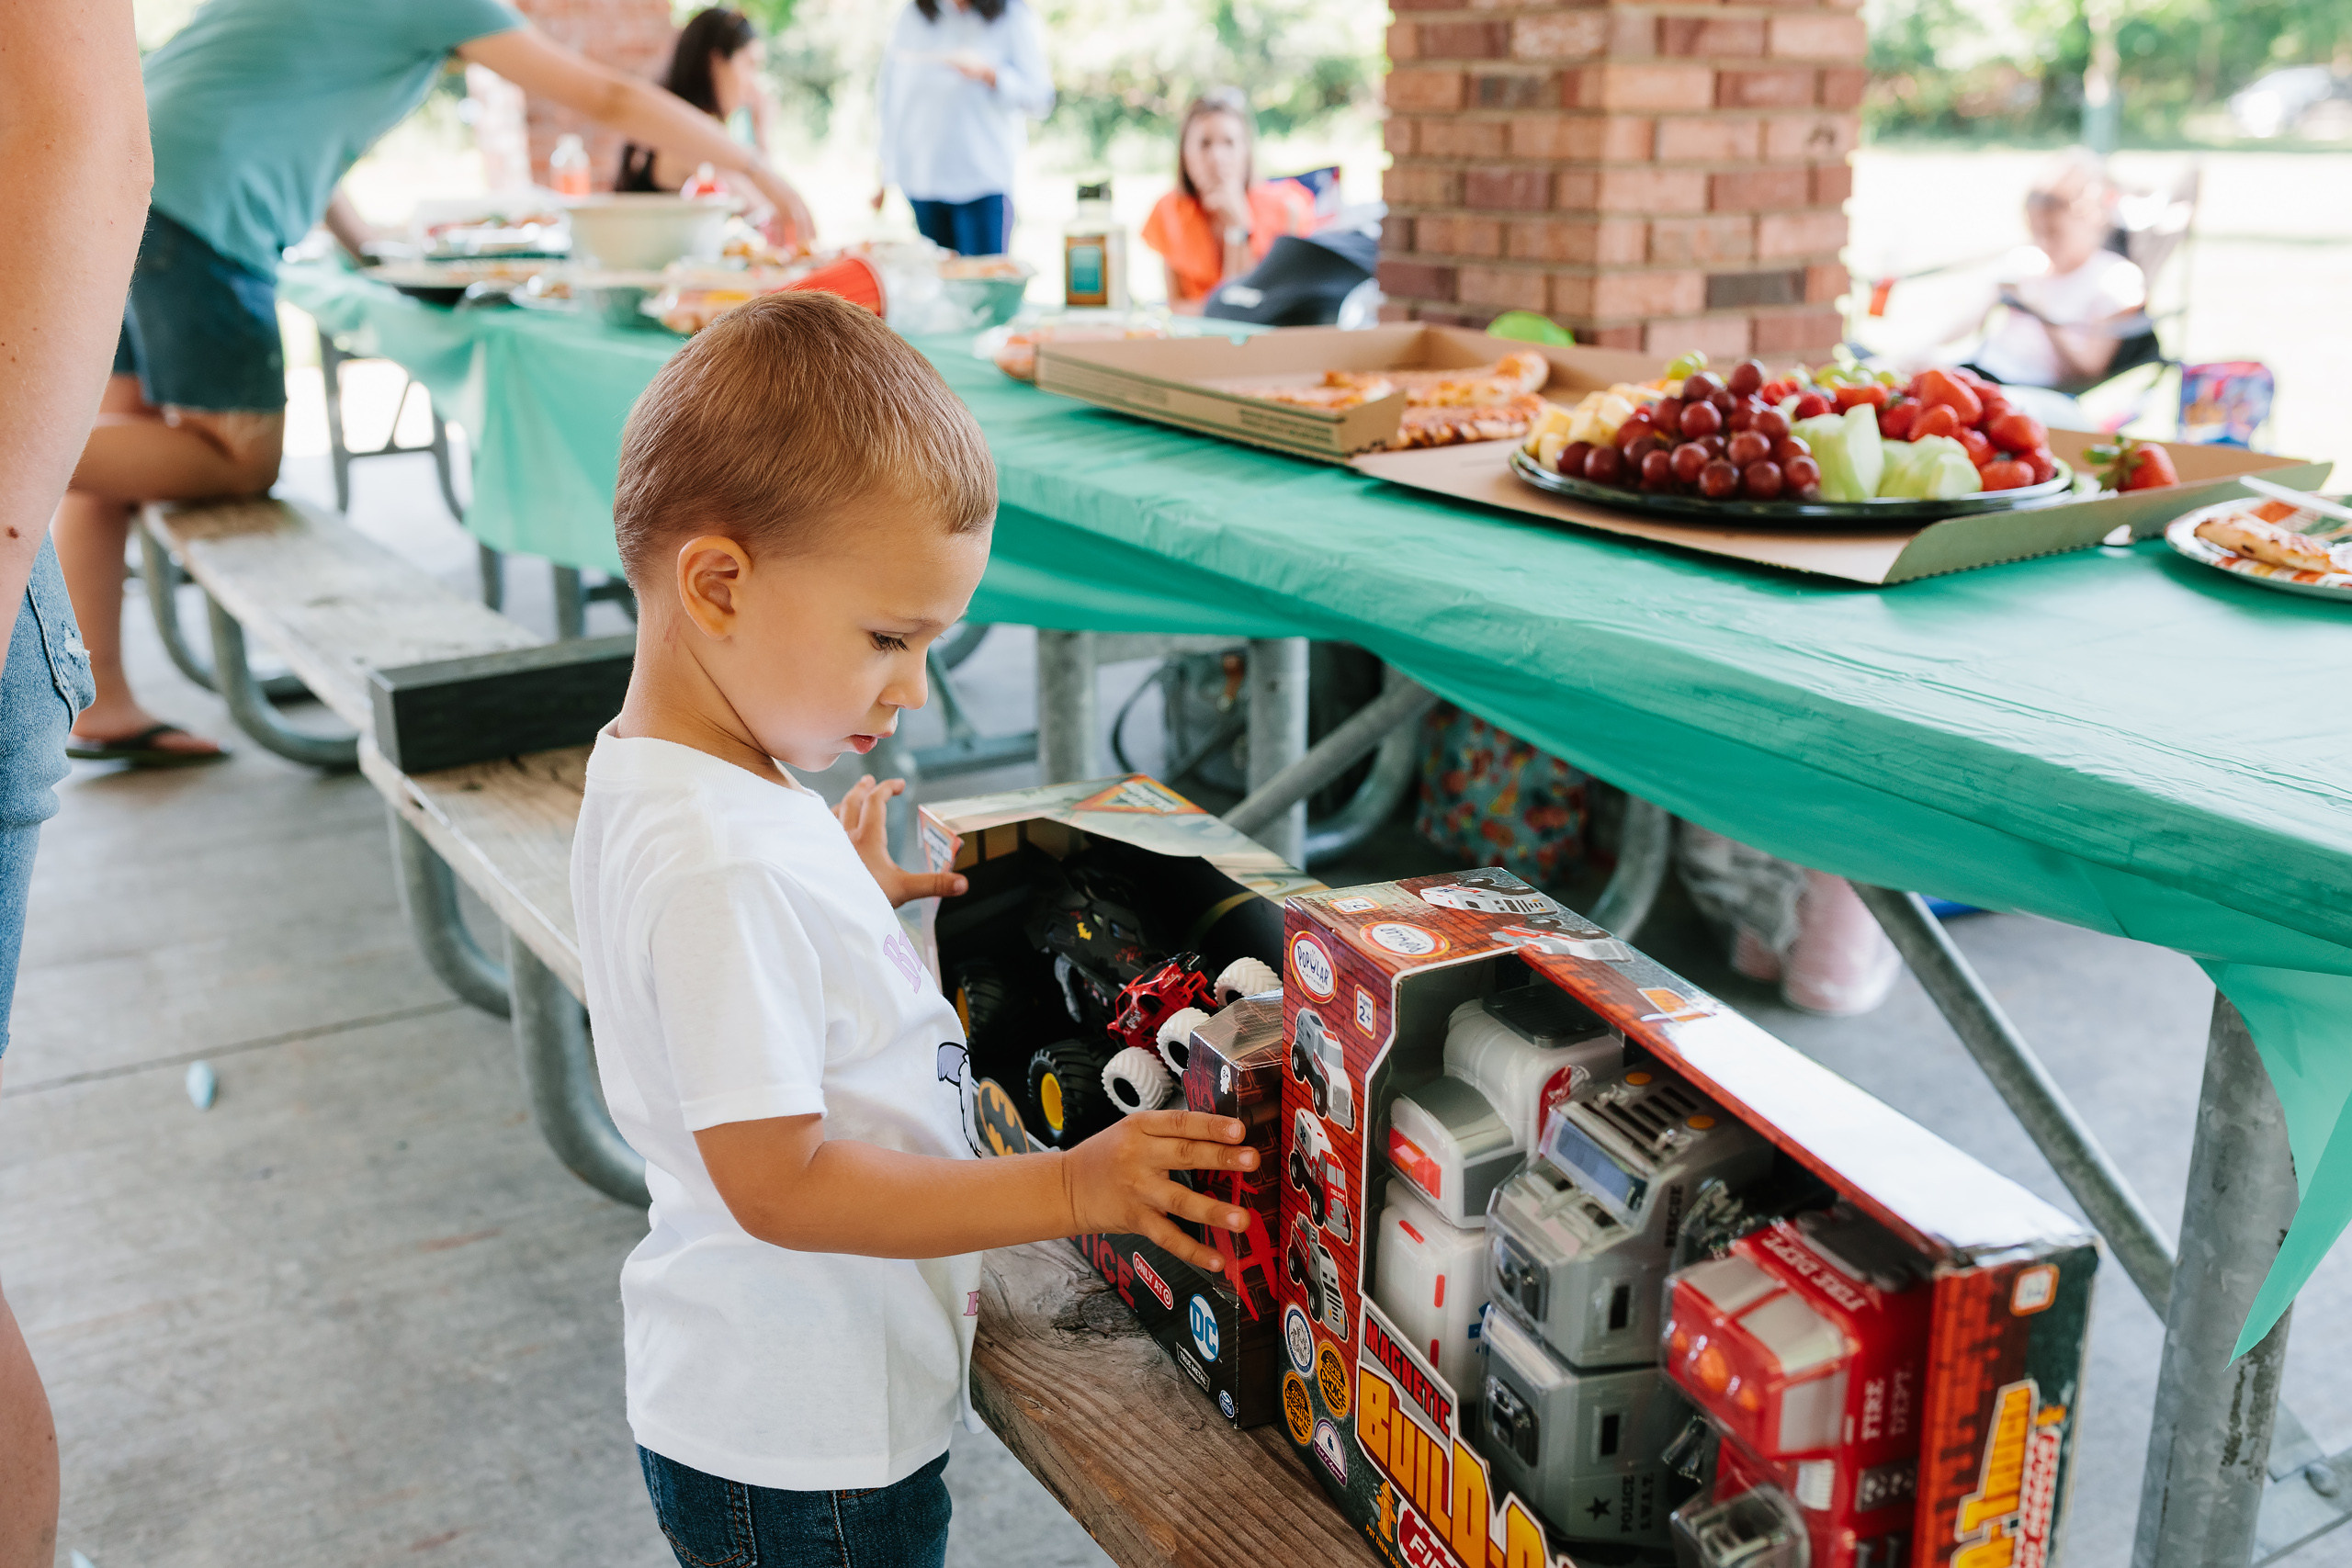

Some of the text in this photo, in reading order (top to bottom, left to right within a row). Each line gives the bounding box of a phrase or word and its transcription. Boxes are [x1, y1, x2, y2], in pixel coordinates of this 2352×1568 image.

[1296, 944, 1329, 987] POPULAR
[1359, 1005, 1371, 1023] 2+
[1069, 1234, 1135, 1311] ICE
[1136, 1258, 1163, 1295] ONLY AT
[1191, 1300, 1218, 1356] DC
[1179, 1350, 1207, 1385] TRUE METAL
[1320, 1367, 1345, 1407] CHOICE
[1365, 1315, 1452, 1442] MAGNETIC
[1861, 1377, 1885, 1441] FIRE
[1358, 1368, 1573, 1568] BUILD-A
[1620, 1473, 1635, 1533] POLICE
[1365, 1524, 1376, 1540] PUT
[1375, 1535, 1389, 1557] THEM
